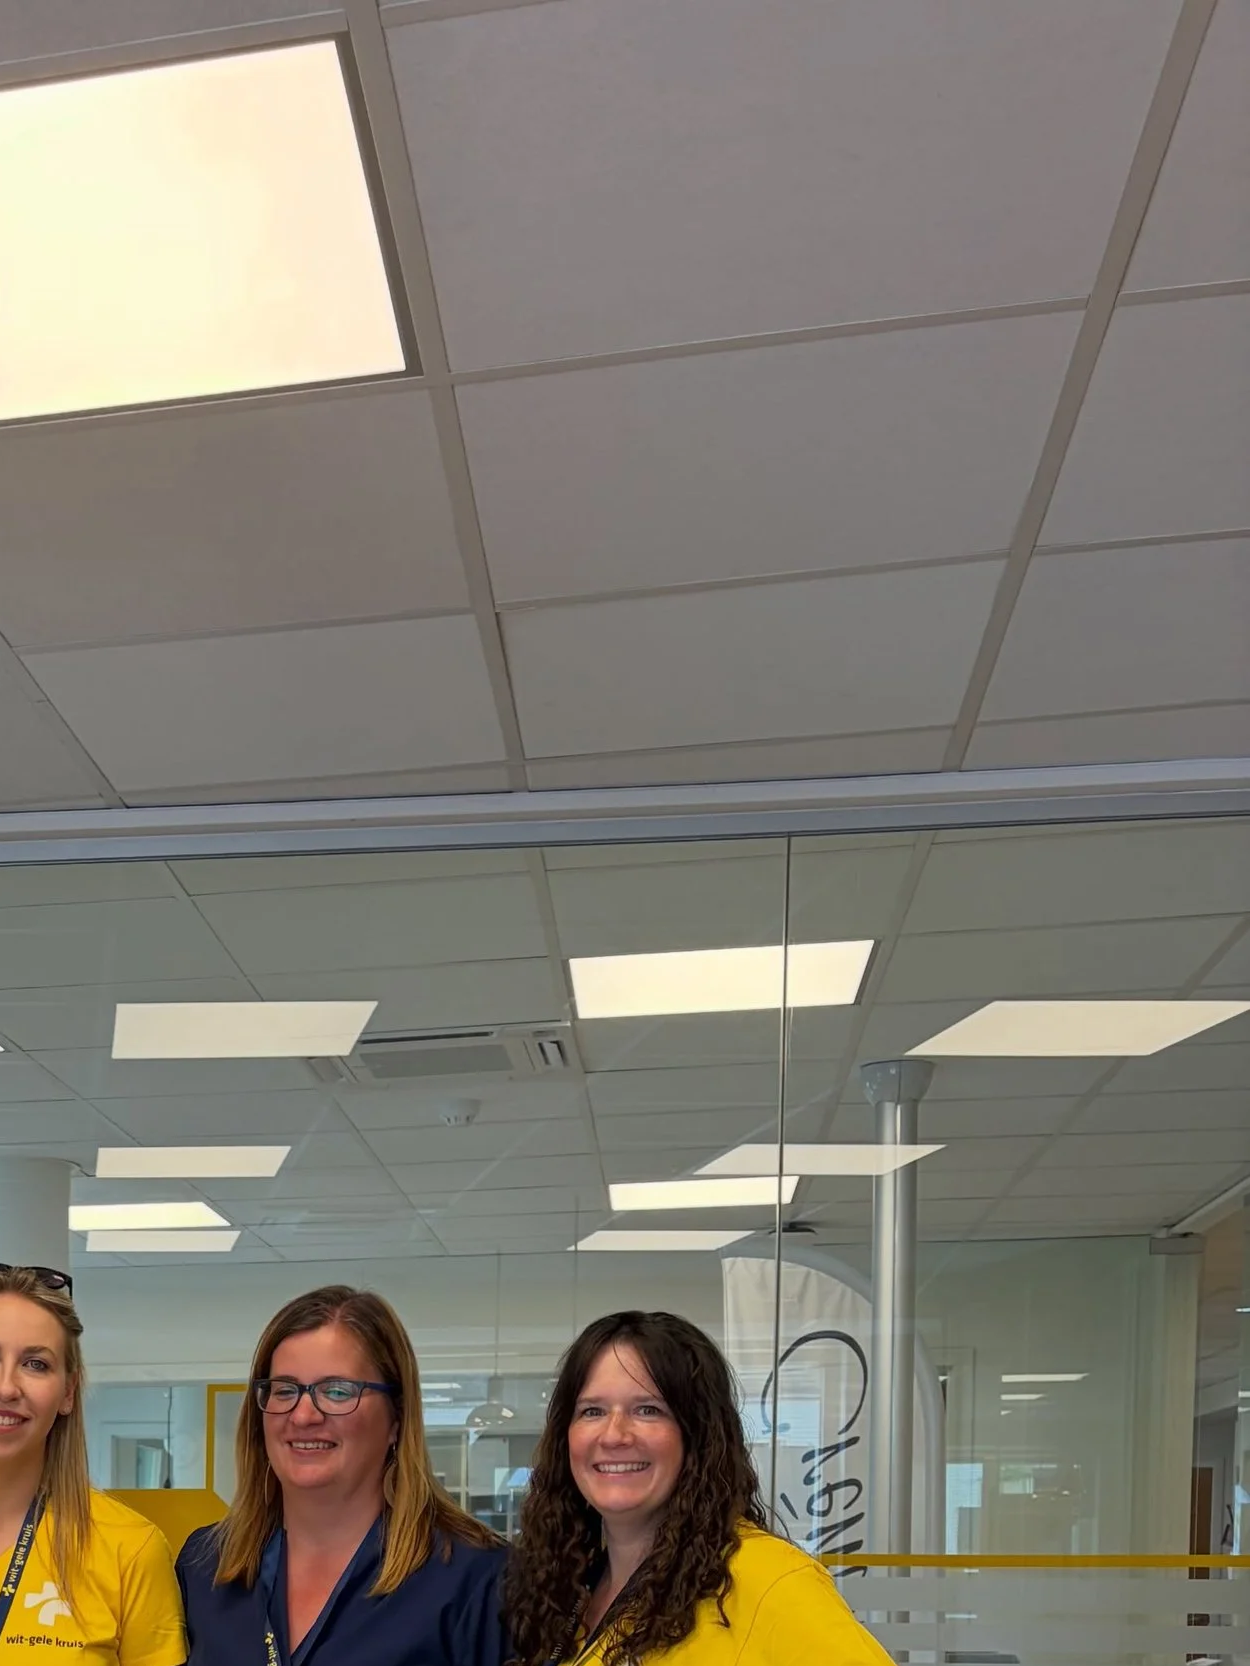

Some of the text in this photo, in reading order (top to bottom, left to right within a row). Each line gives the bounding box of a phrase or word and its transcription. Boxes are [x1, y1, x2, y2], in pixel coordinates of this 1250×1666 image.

[9, 1523, 34, 1583] wit-gele kruis
[6, 1633, 84, 1648] wit-gele kruis
